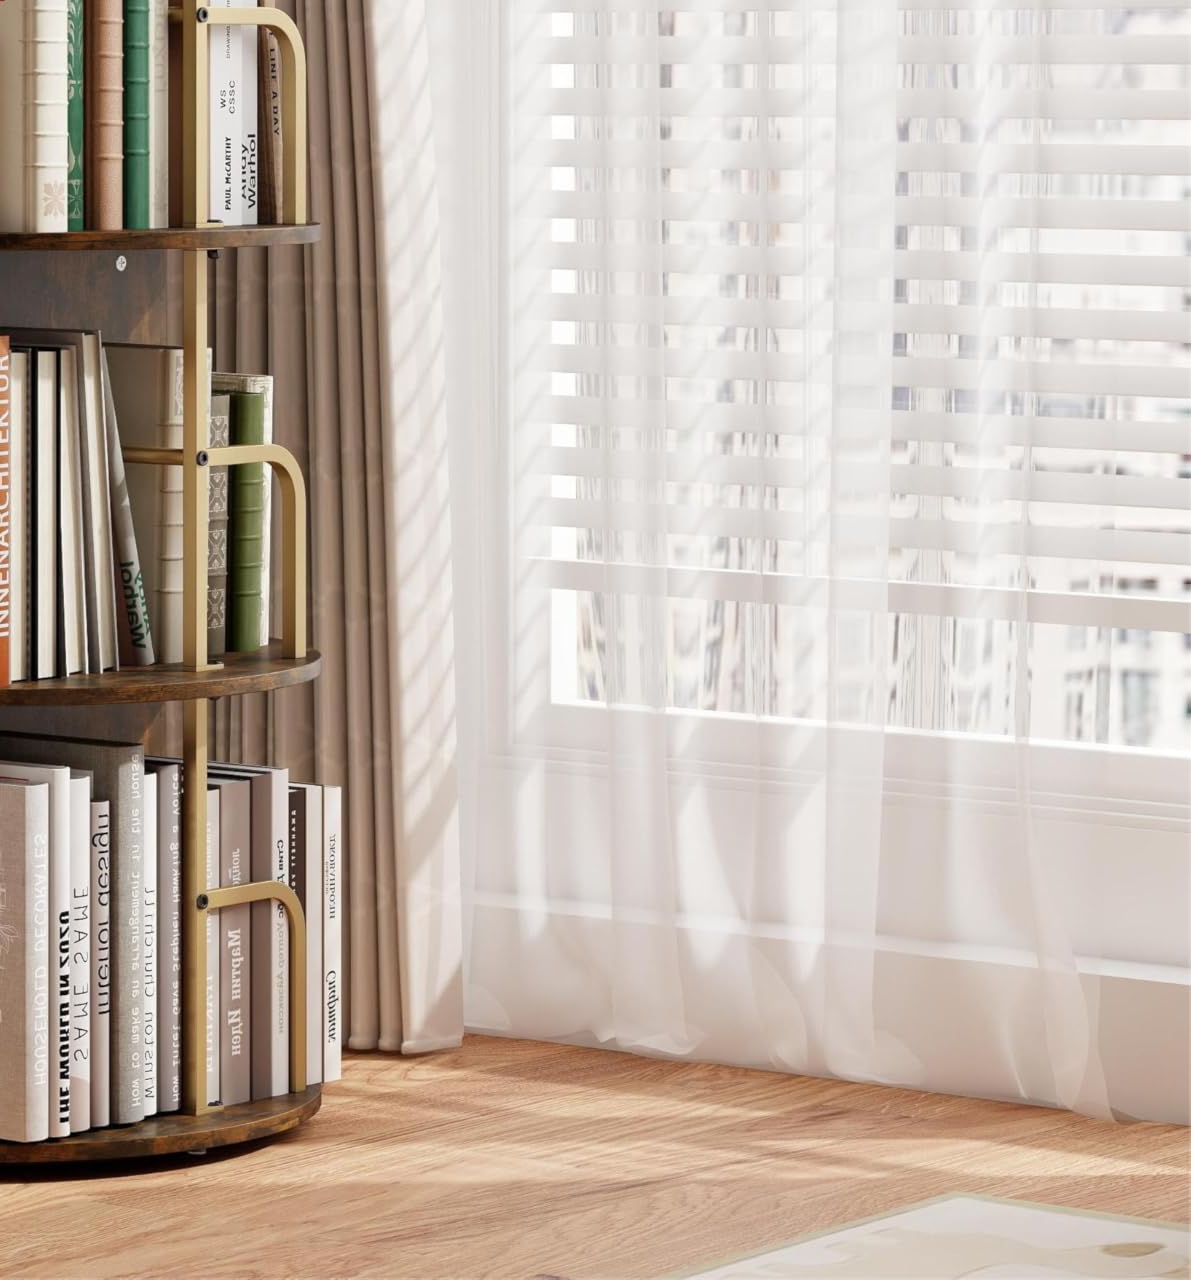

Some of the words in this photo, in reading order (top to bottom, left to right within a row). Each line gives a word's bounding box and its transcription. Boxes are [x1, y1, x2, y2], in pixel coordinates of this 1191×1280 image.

[220, 90, 227, 109] WS
[272, 106, 280, 135] DAY
[248, 133, 256, 209] Warhol
